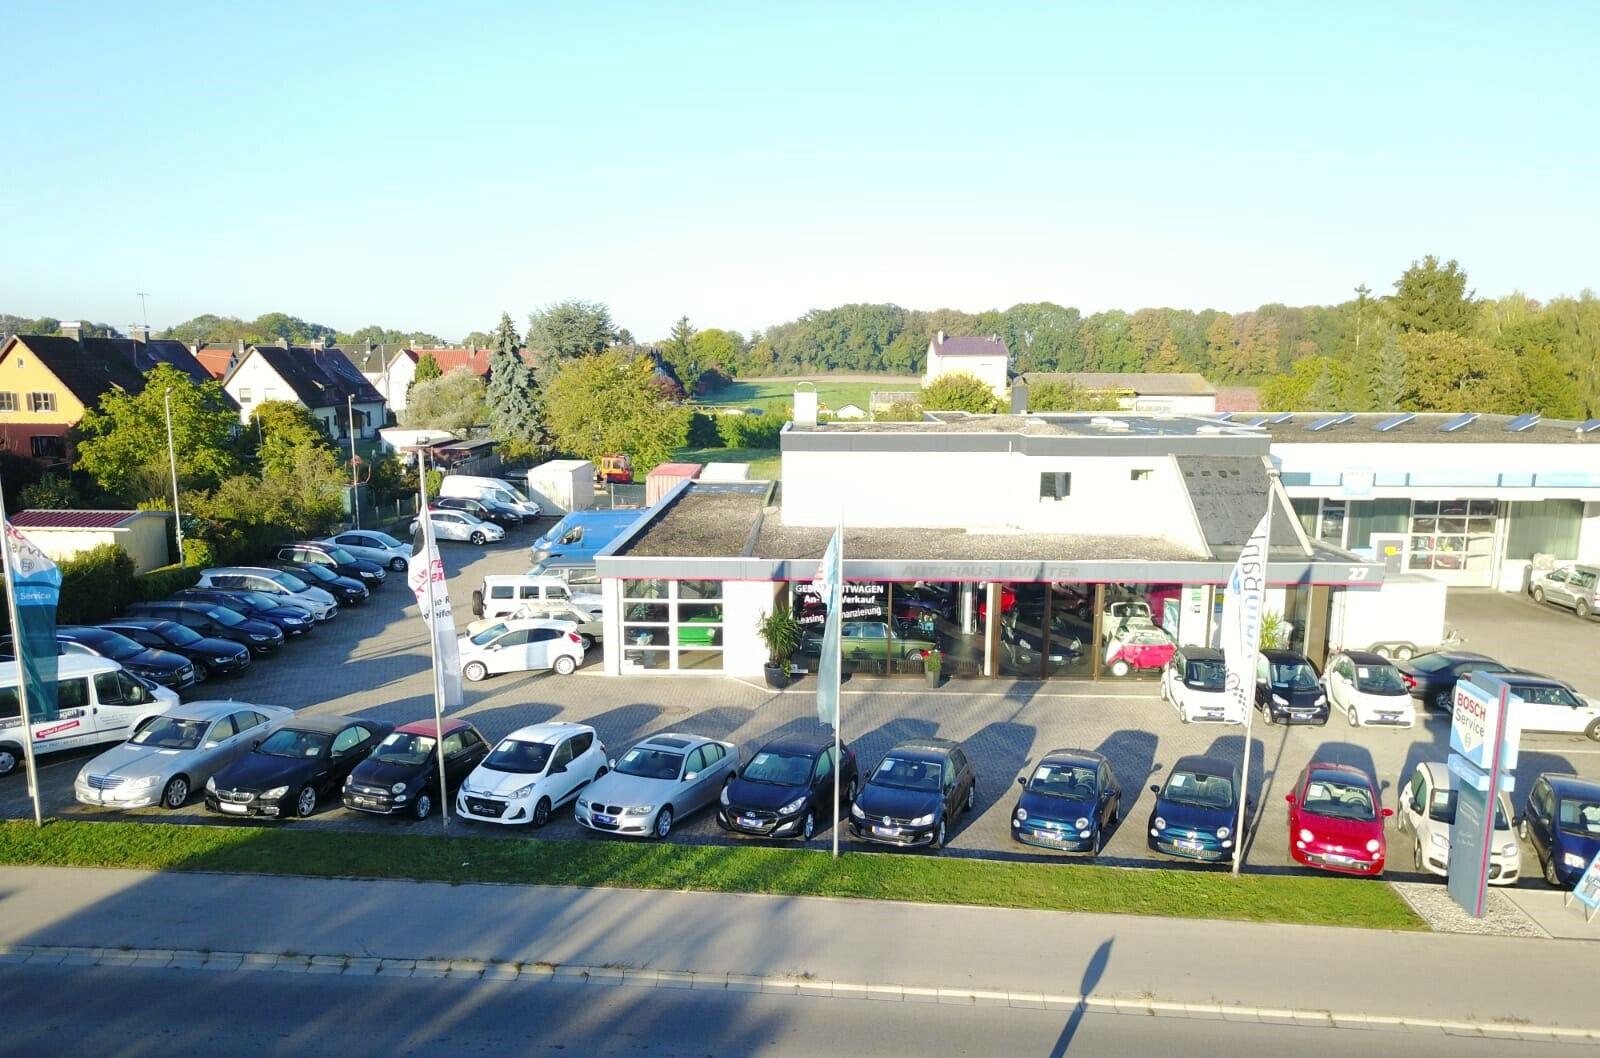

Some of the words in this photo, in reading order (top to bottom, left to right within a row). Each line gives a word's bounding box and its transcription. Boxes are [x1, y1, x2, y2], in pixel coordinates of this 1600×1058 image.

[903, 566, 993, 577] AUTOHAUS
[1348, 567, 1369, 581] 27
[795, 584, 884, 593] GEBTWAGEN
[19, 591, 52, 601] Service
[804, 595, 820, 604] An-
[841, 596, 876, 604] Verkauf
[841, 607, 882, 620] nanzierung
[1457, 692, 1487, 722] BOSCH
[1455, 708, 1485, 738] Service
